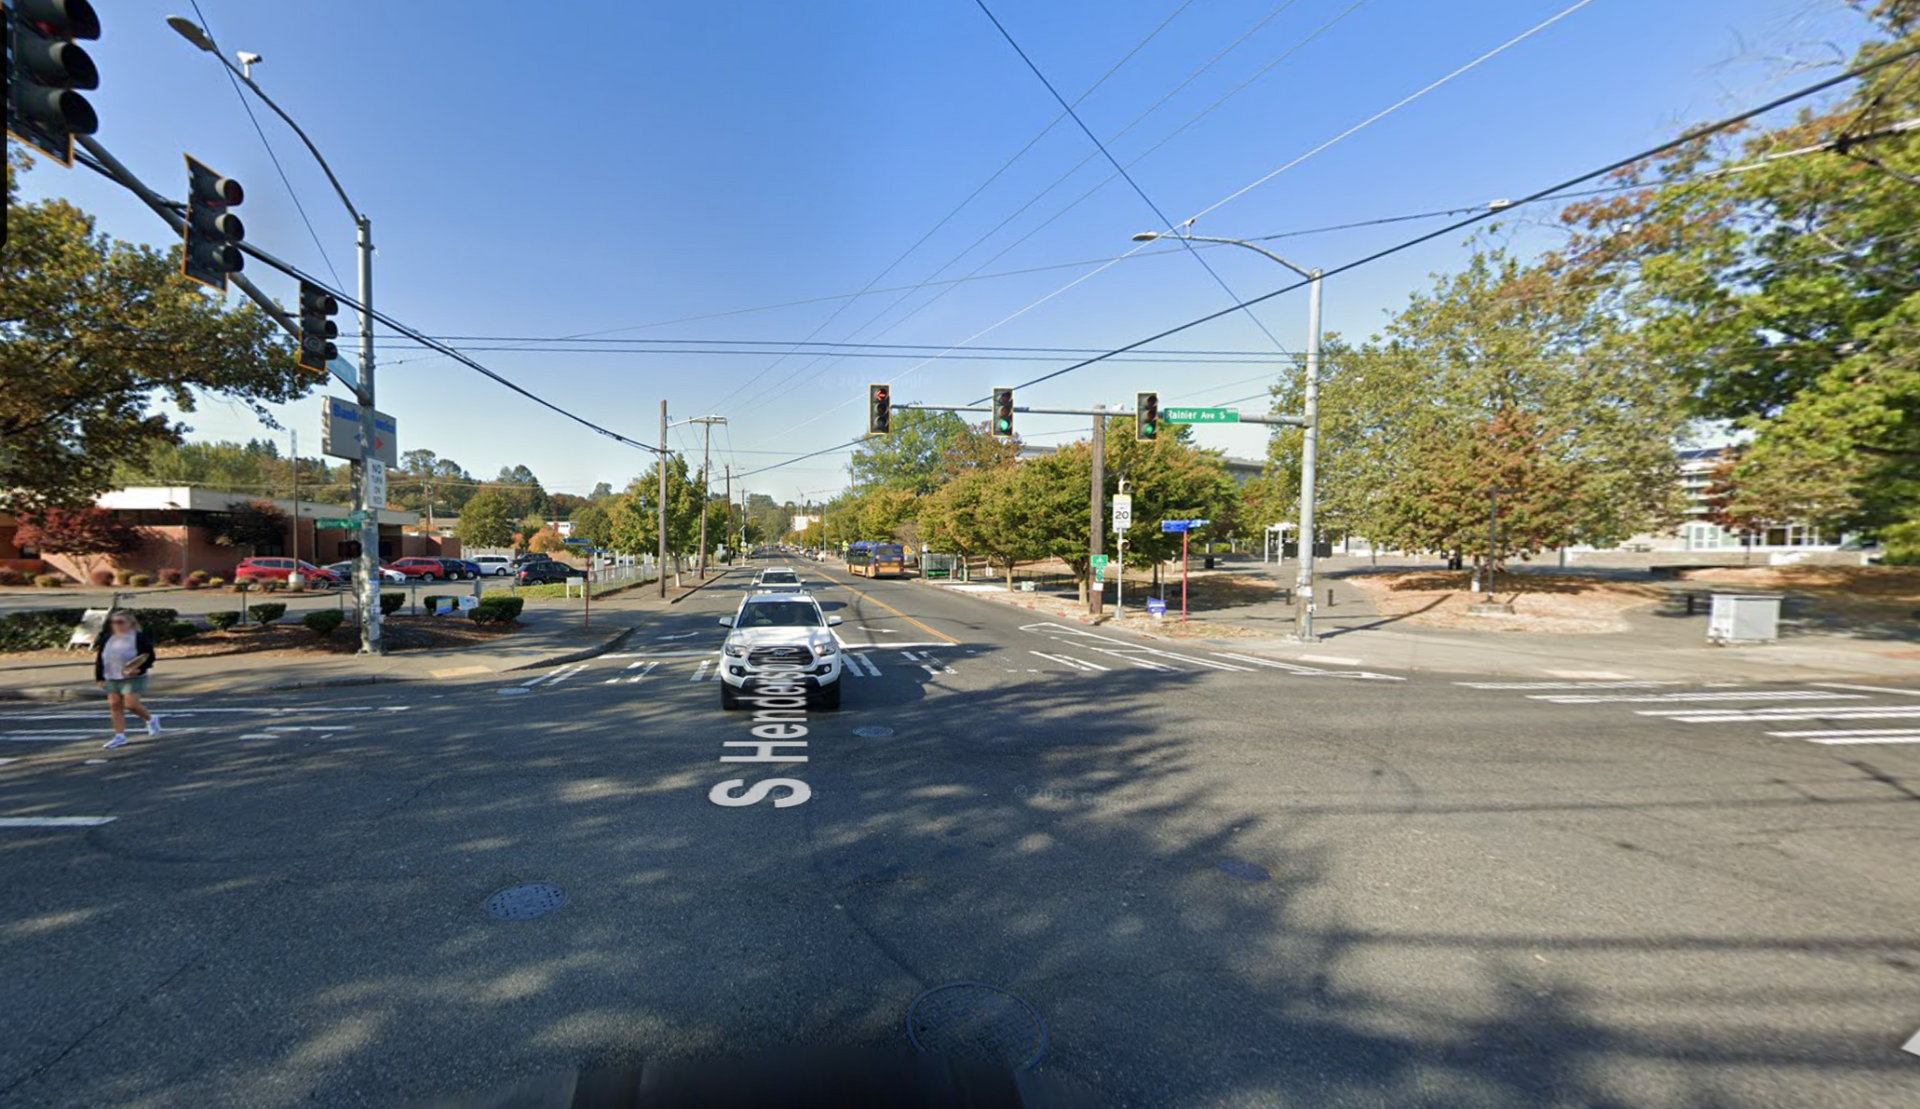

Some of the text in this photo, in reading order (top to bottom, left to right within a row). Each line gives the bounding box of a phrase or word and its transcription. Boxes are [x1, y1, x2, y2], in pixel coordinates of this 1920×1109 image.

[1167, 410, 1225, 420] Rainier Ave S
[371, 463, 381, 475] NO
[1115, 510, 1129, 520] 20
